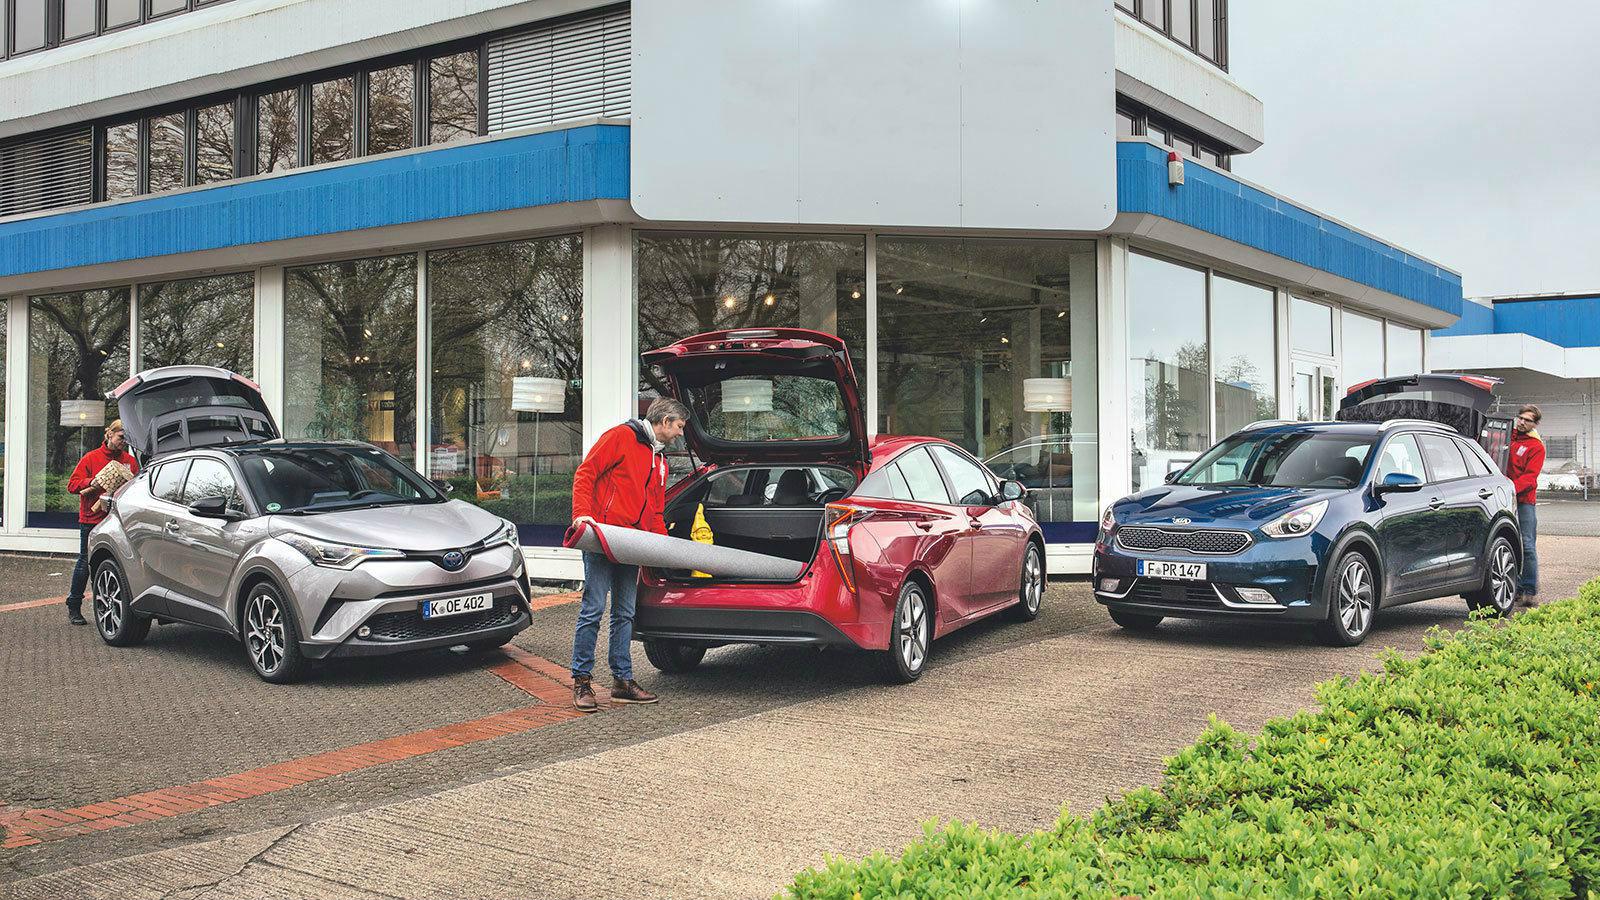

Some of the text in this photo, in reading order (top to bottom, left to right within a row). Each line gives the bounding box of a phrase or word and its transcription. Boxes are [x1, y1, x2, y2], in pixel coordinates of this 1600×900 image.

[1148, 562, 1155, 575] F
[1162, 563, 1177, 576] PR
[1179, 564, 1201, 577] 147
[431, 595, 484, 616] K OE 402
